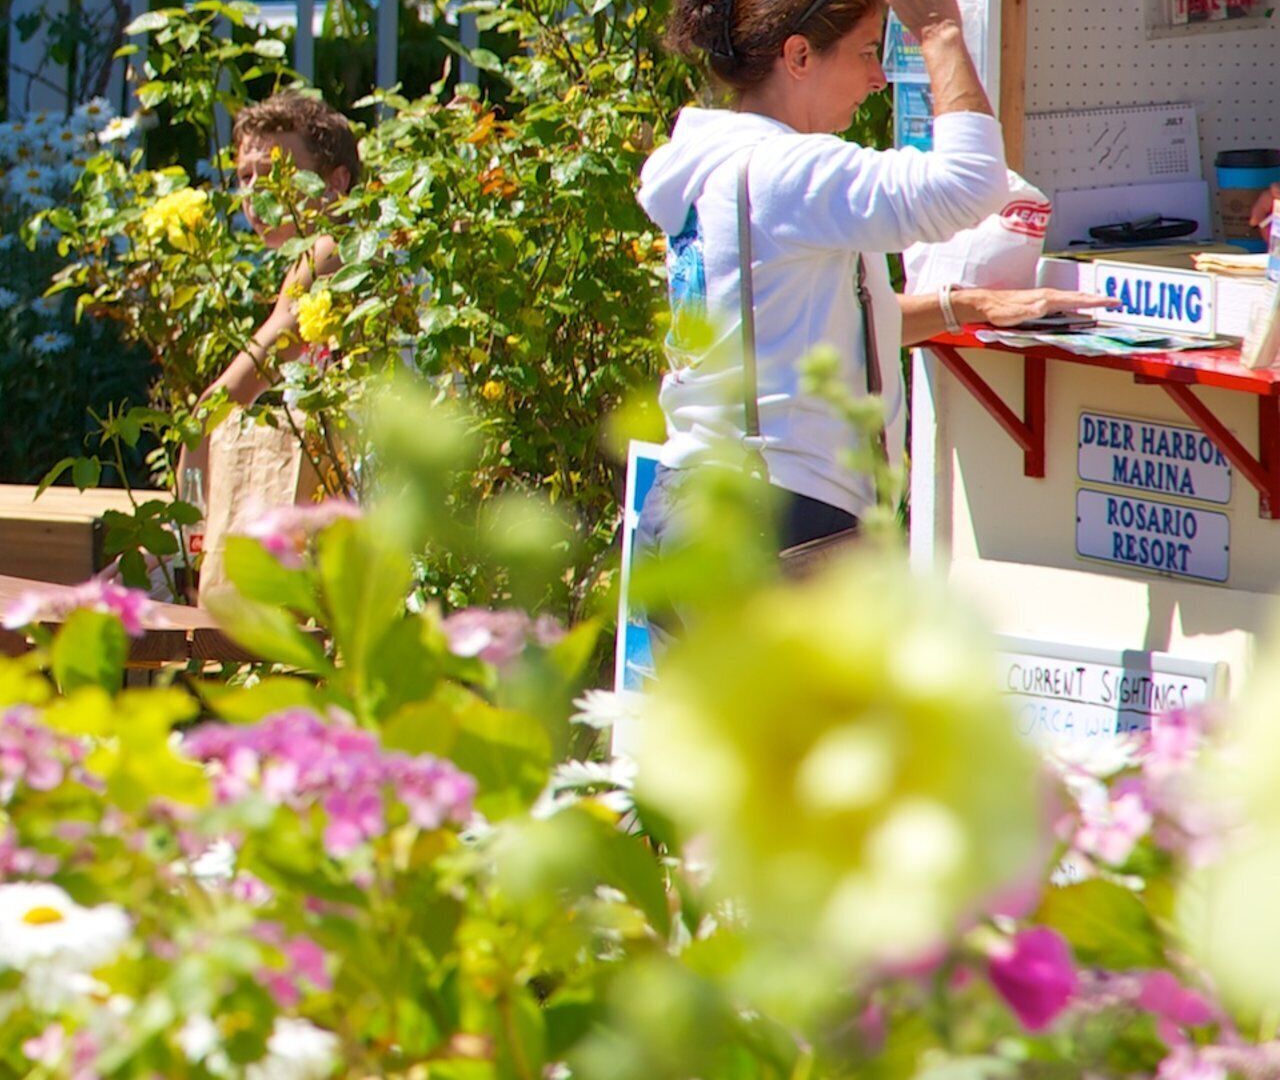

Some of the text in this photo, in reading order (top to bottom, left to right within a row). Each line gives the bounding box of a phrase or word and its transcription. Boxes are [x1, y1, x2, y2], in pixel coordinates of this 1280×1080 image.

[1105, 276, 1203, 323] SAILING
[1083, 417, 1135, 452] DEER
[1113, 454, 1195, 495] MARINA
[1107, 498, 1197, 540] ROSARIO
[1113, 531, 1192, 572] RESORT
[1007, 663, 1189, 710] CURRENT SIGHTINGS
[1016, 703, 1075, 736] ORCA
